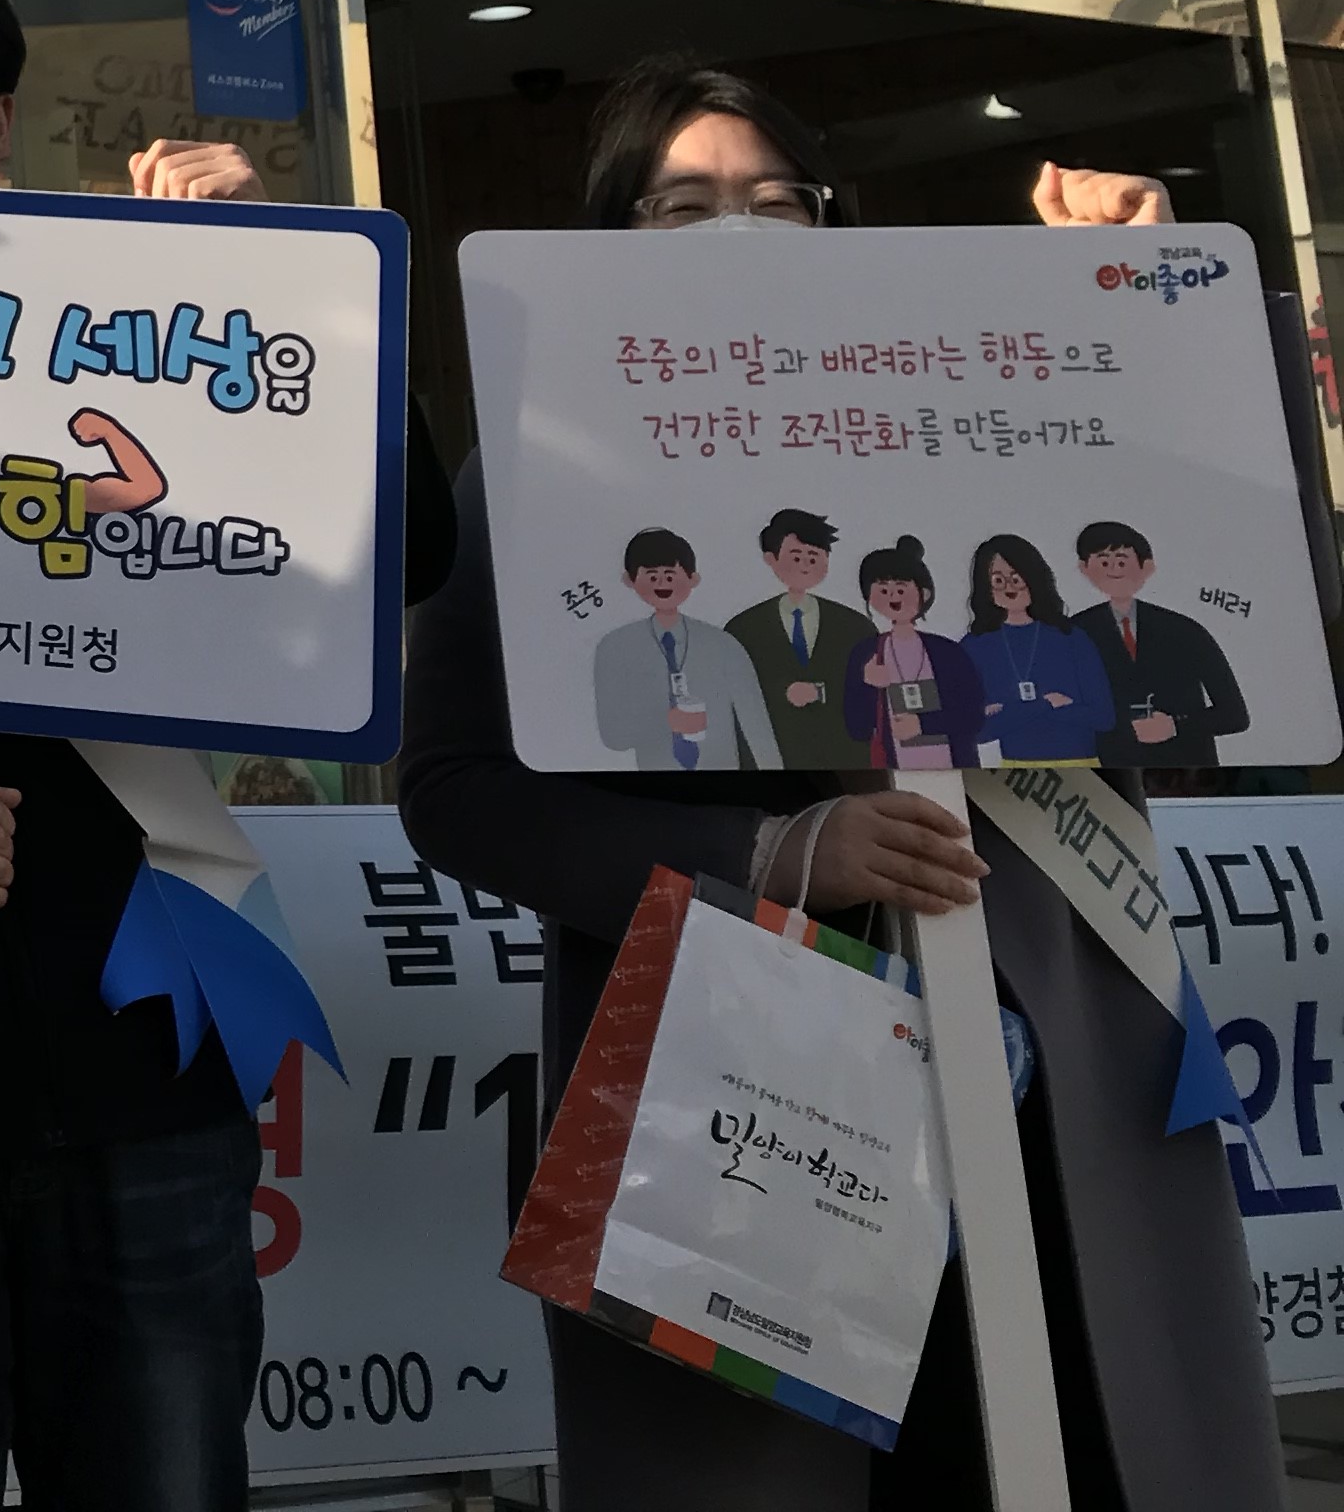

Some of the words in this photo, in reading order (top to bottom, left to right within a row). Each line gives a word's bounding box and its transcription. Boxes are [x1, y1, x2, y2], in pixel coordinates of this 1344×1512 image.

[239, 2, 295, 37] Members
[1095, 261, 1230, 306] 아이좋아
[47, 301, 316, 417] 세상을
[615, 334, 718, 384] 존중의
[728, 332, 810, 386] 말과
[820, 335, 967, 382] 배려하는
[979, 331, 1123, 381] 행동으로
[642, 406, 763, 459] 건강한
[780, 406, 944, 458] 조직문화를
[953, 408, 1116, 458] 만들어가요
[560, 580, 604, 620] 존중
[1198, 586, 1252, 619] 배려
[892, 1022, 931, 1064] 아이좋
[259, 1351, 434, 1433] 08:00
